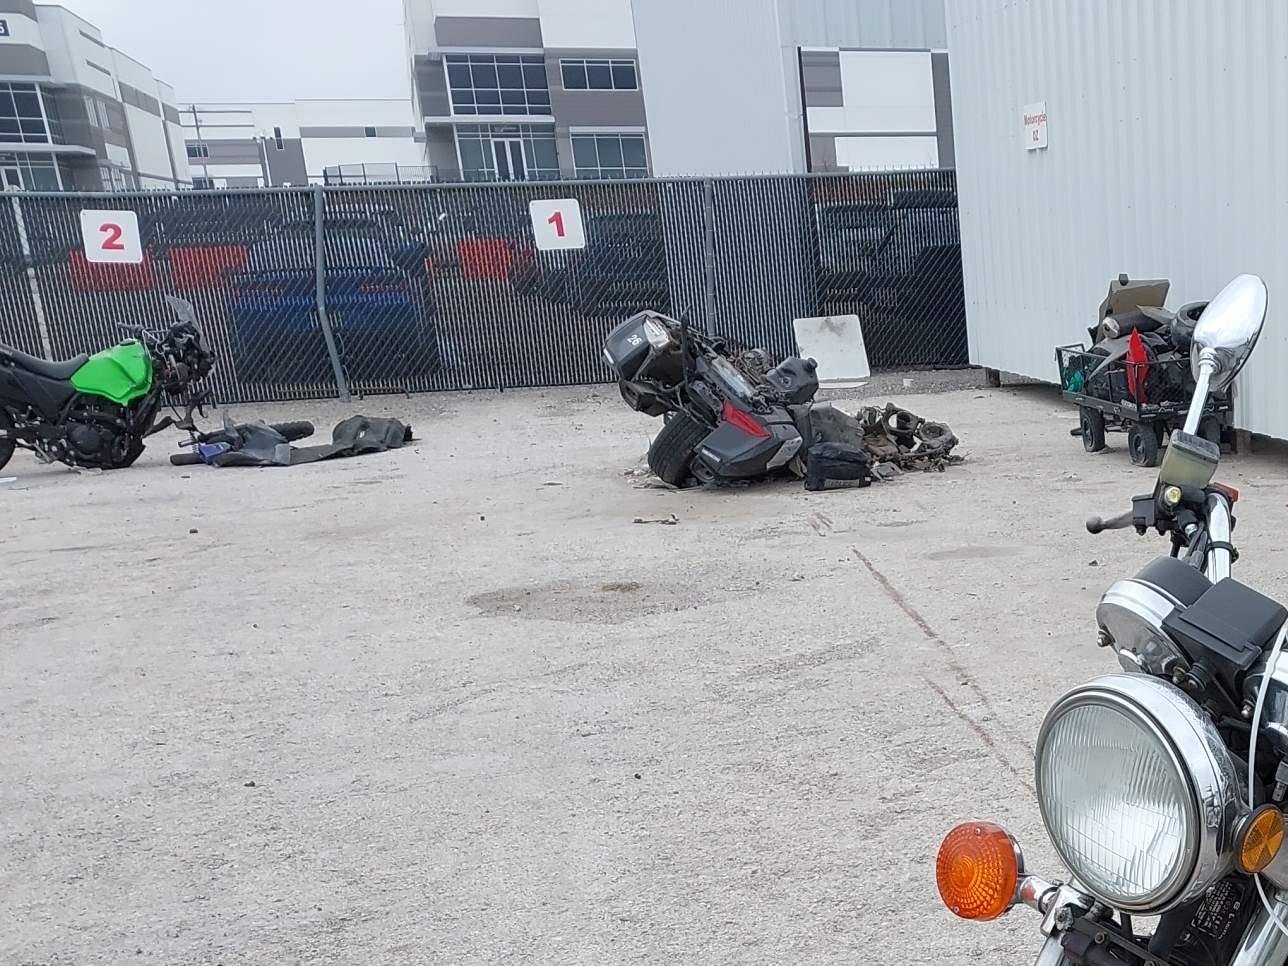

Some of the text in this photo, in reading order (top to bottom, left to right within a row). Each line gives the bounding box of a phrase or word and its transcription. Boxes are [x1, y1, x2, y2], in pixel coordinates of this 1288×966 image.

[100, 223, 125, 249] 2
[548, 212, 565, 237] 1
[627, 334, 642, 346] 26
